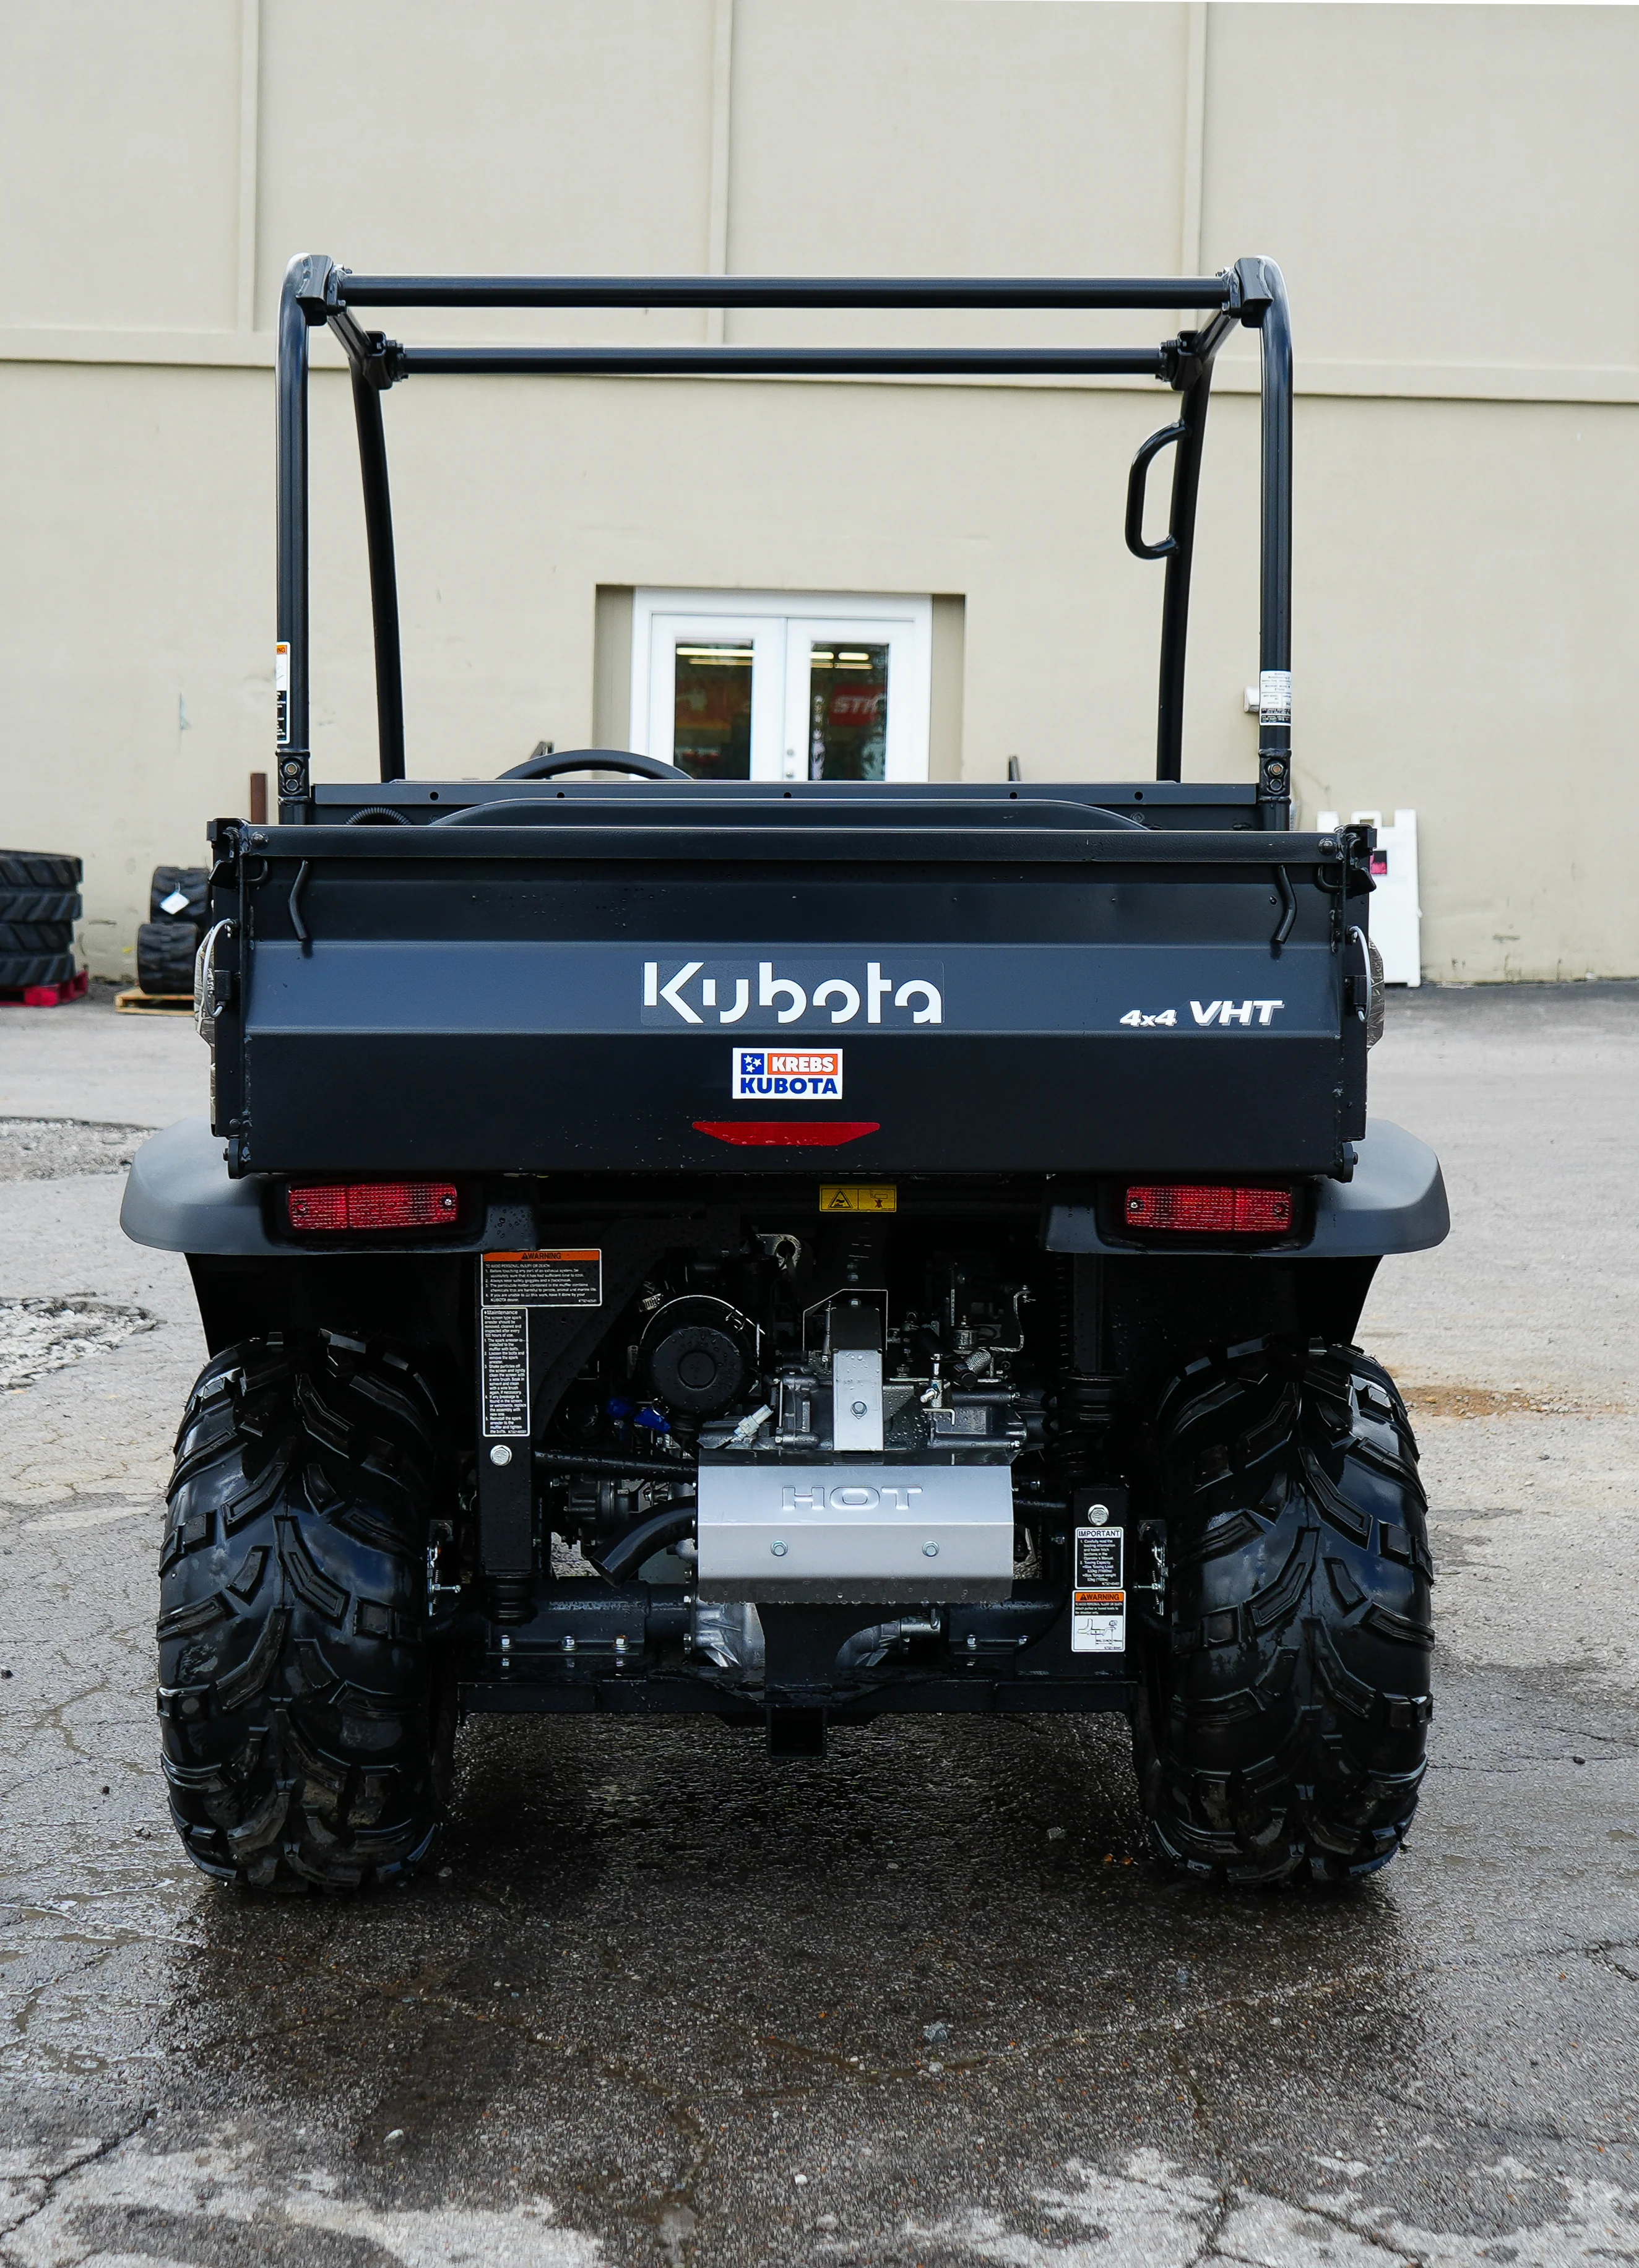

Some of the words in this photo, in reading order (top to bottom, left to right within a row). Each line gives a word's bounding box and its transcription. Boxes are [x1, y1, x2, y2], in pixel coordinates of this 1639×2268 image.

[643, 962, 942, 1024] Kubota
[1120, 1009, 1177, 1027] 4x4
[1190, 1000, 1286, 1027] VHT
[772, 1056, 834, 1072] KREBS
[741, 1077, 837, 1094] KUBOTA
[782, 1486, 923, 1511] HOT
